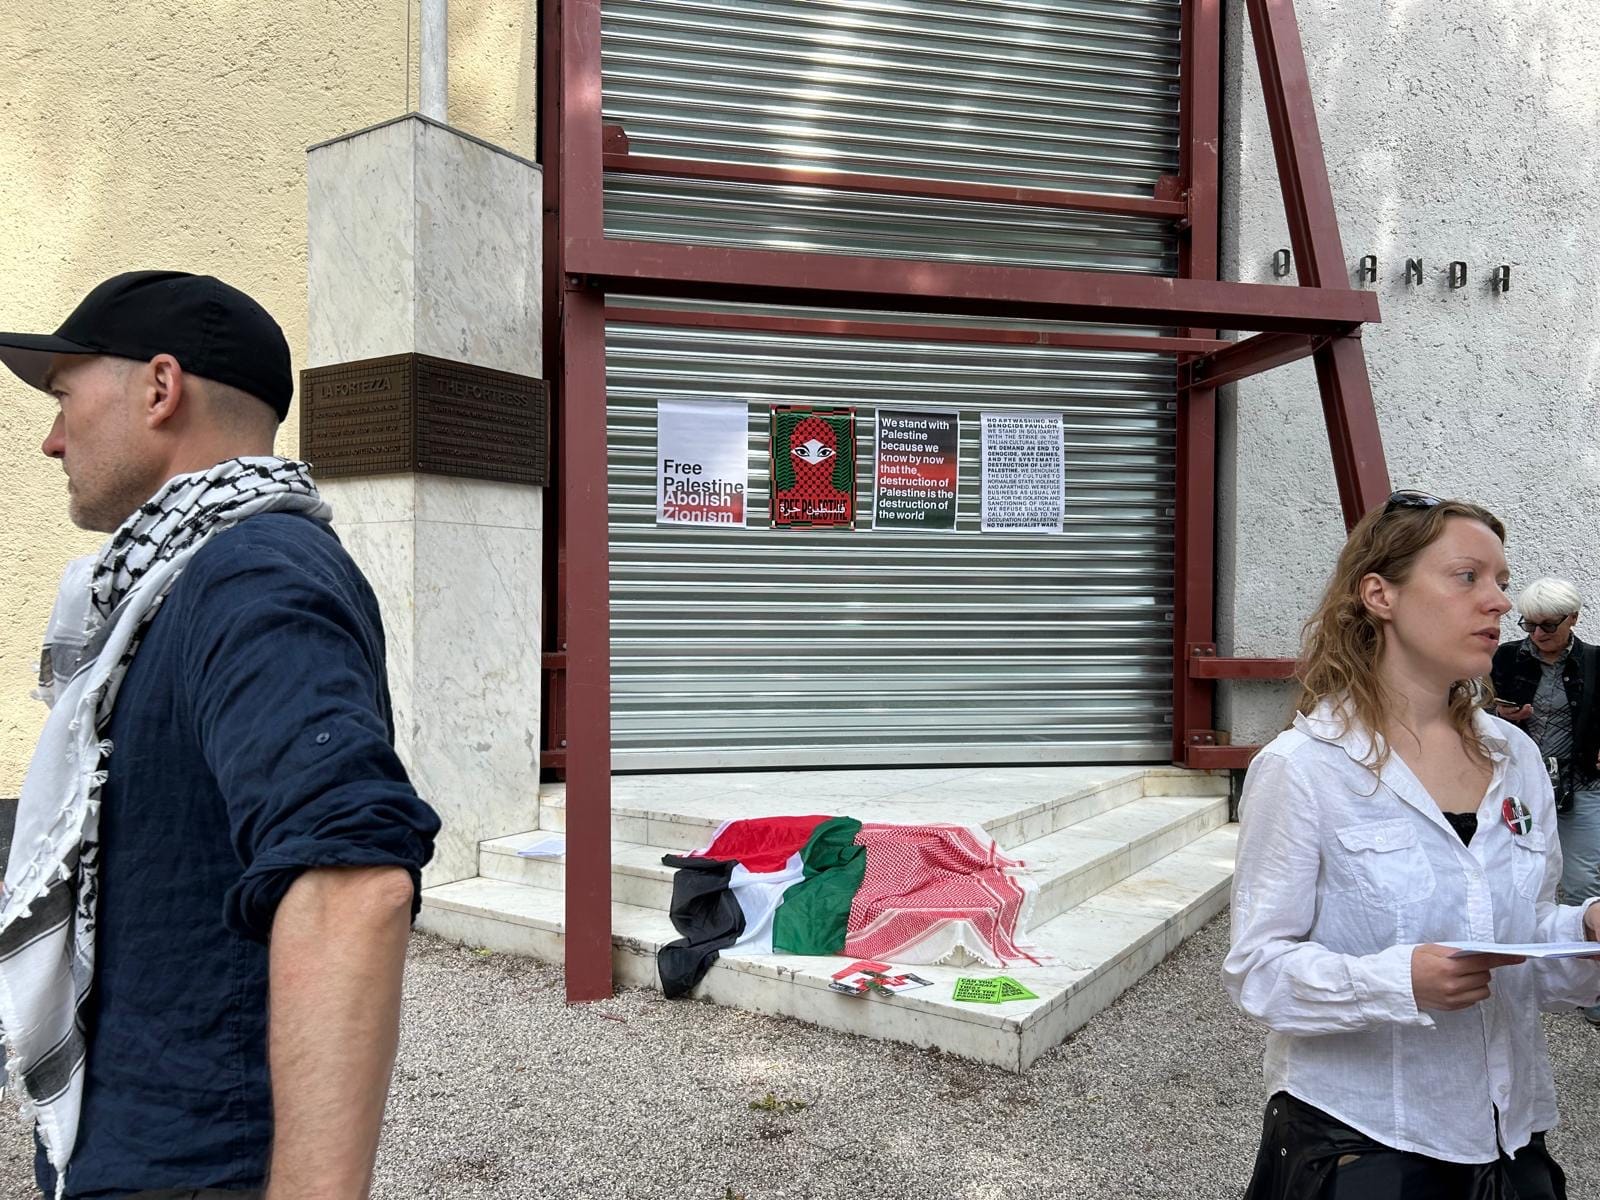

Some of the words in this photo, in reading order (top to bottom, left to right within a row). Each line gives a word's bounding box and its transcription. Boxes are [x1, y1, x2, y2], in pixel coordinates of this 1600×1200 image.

[1272, 249, 1511, 292] OANDA
[321, 386, 333, 399] LA
[336, 377, 391, 397] FORTEZZA
[437, 379, 465, 395] THE
[466, 384, 528, 405] FORTRESS
[881, 418, 897, 428] We
[899, 420, 927, 429] stand
[929, 421, 949, 430] with
[881, 430, 927, 440] Palestine
[881, 442, 923, 452] because
[881, 453, 908, 462] know
[910, 454, 922, 465] by
[923, 456, 944, 464] now
[664, 460, 702, 475] Free
[880, 465, 900, 474] that
[901, 466, 917, 474] the
[664, 477, 744, 494] Palestine
[880, 476, 937, 487] destruction
[939, 478, 949, 487] of
[664, 491, 731, 507] Abolish
[880, 488, 926, 497] Palestine
[928, 489, 936, 498] is
[937, 490, 953, 498] the
[779, 499, 799, 519] FREE
[802, 499, 847, 520] PALESTINE
[780, 504, 800, 516] حرة
[807, 504, 845, 515] فلسطين
[879, 499, 935, 509] destruction
[937, 501, 948, 510] of
[664, 507, 733, 523] Zionism
[879, 510, 895, 519] the
[897, 511, 924, 520] world
